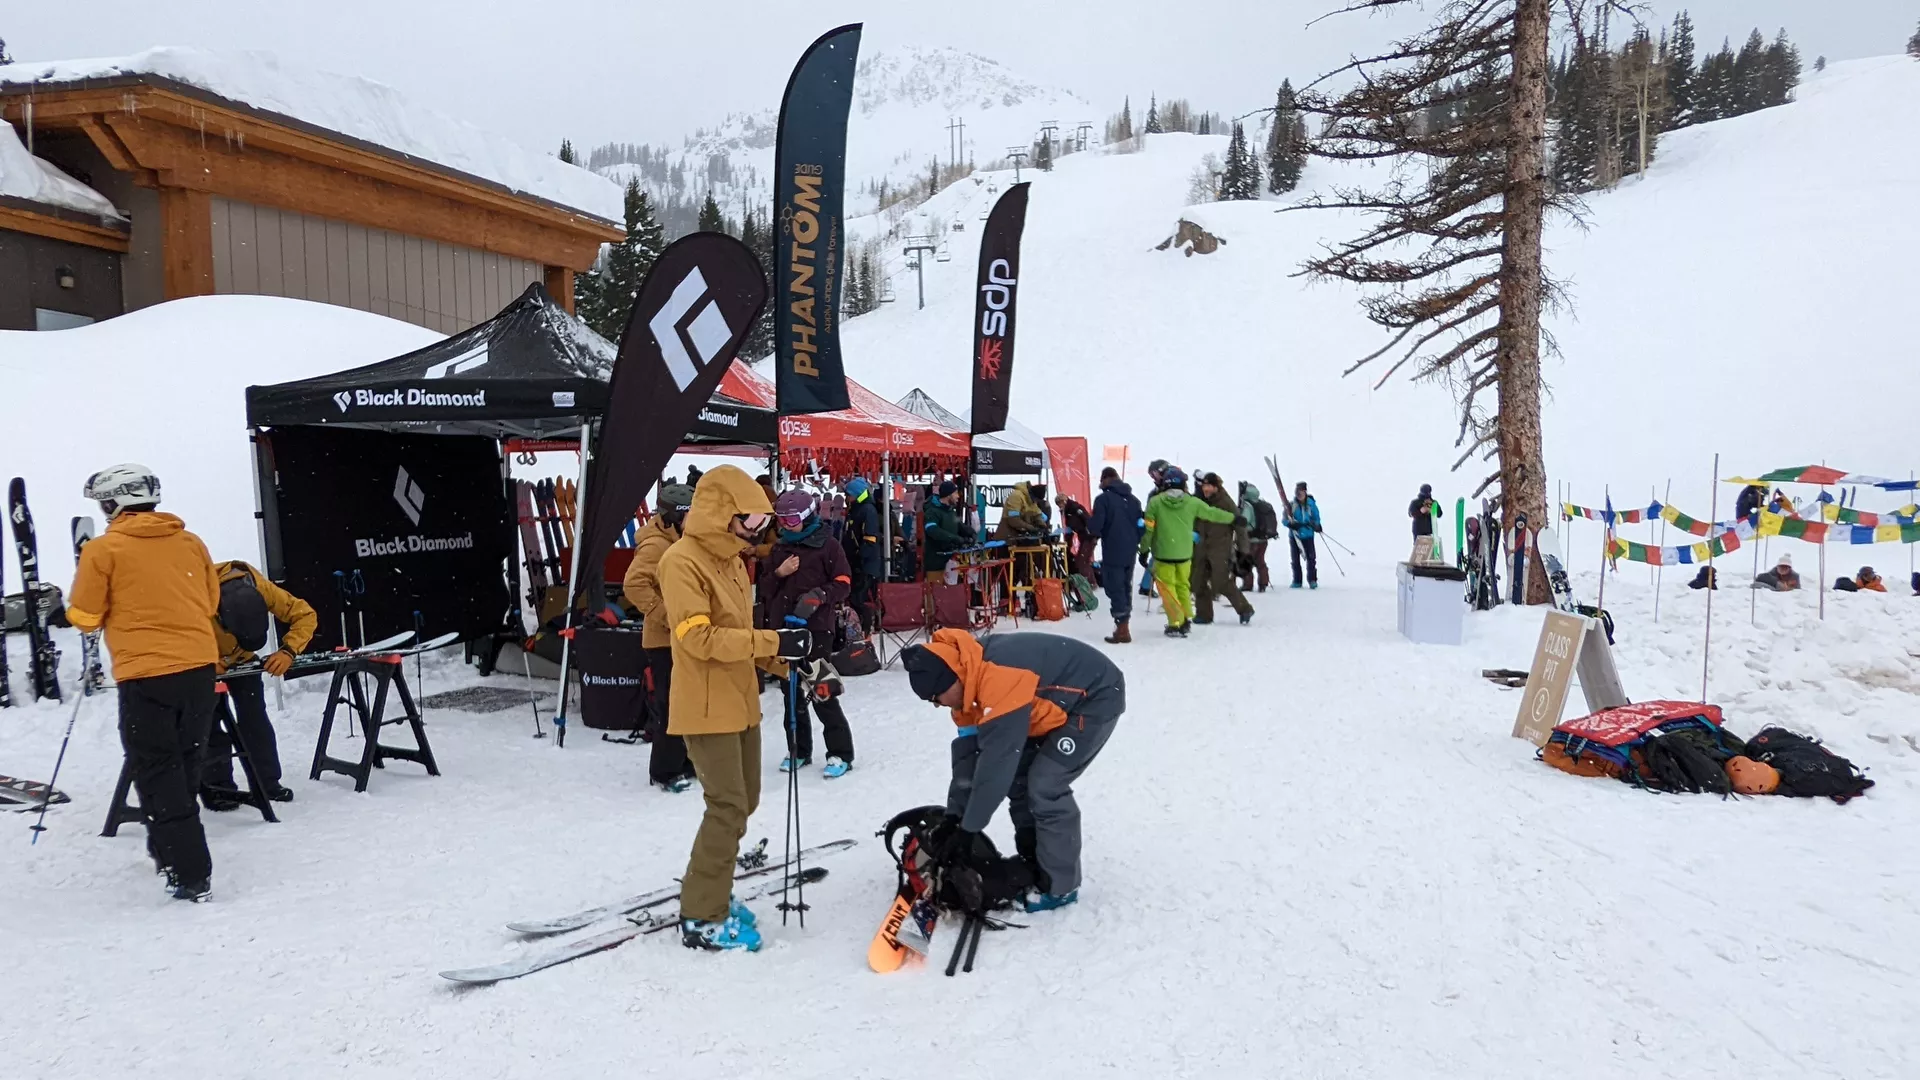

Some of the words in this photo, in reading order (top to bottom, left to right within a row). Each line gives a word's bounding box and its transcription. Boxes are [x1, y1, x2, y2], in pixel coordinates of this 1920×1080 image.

[790, 174, 824, 379] PHANTOM
[981, 258, 1017, 337] dps
[355, 388, 404, 406] Black
[407, 388, 486, 407] Diamond
[780, 417, 801, 442] dps
[892, 428, 907, 451] dps
[355, 536, 408, 558] Black
[408, 532, 474, 552] Diamond
[1544, 631, 1571, 659] CLASS
[592, 675, 617, 685] Black
[1542, 660, 1559, 682] PIT
[1536, 694, 1545, 716] 2
